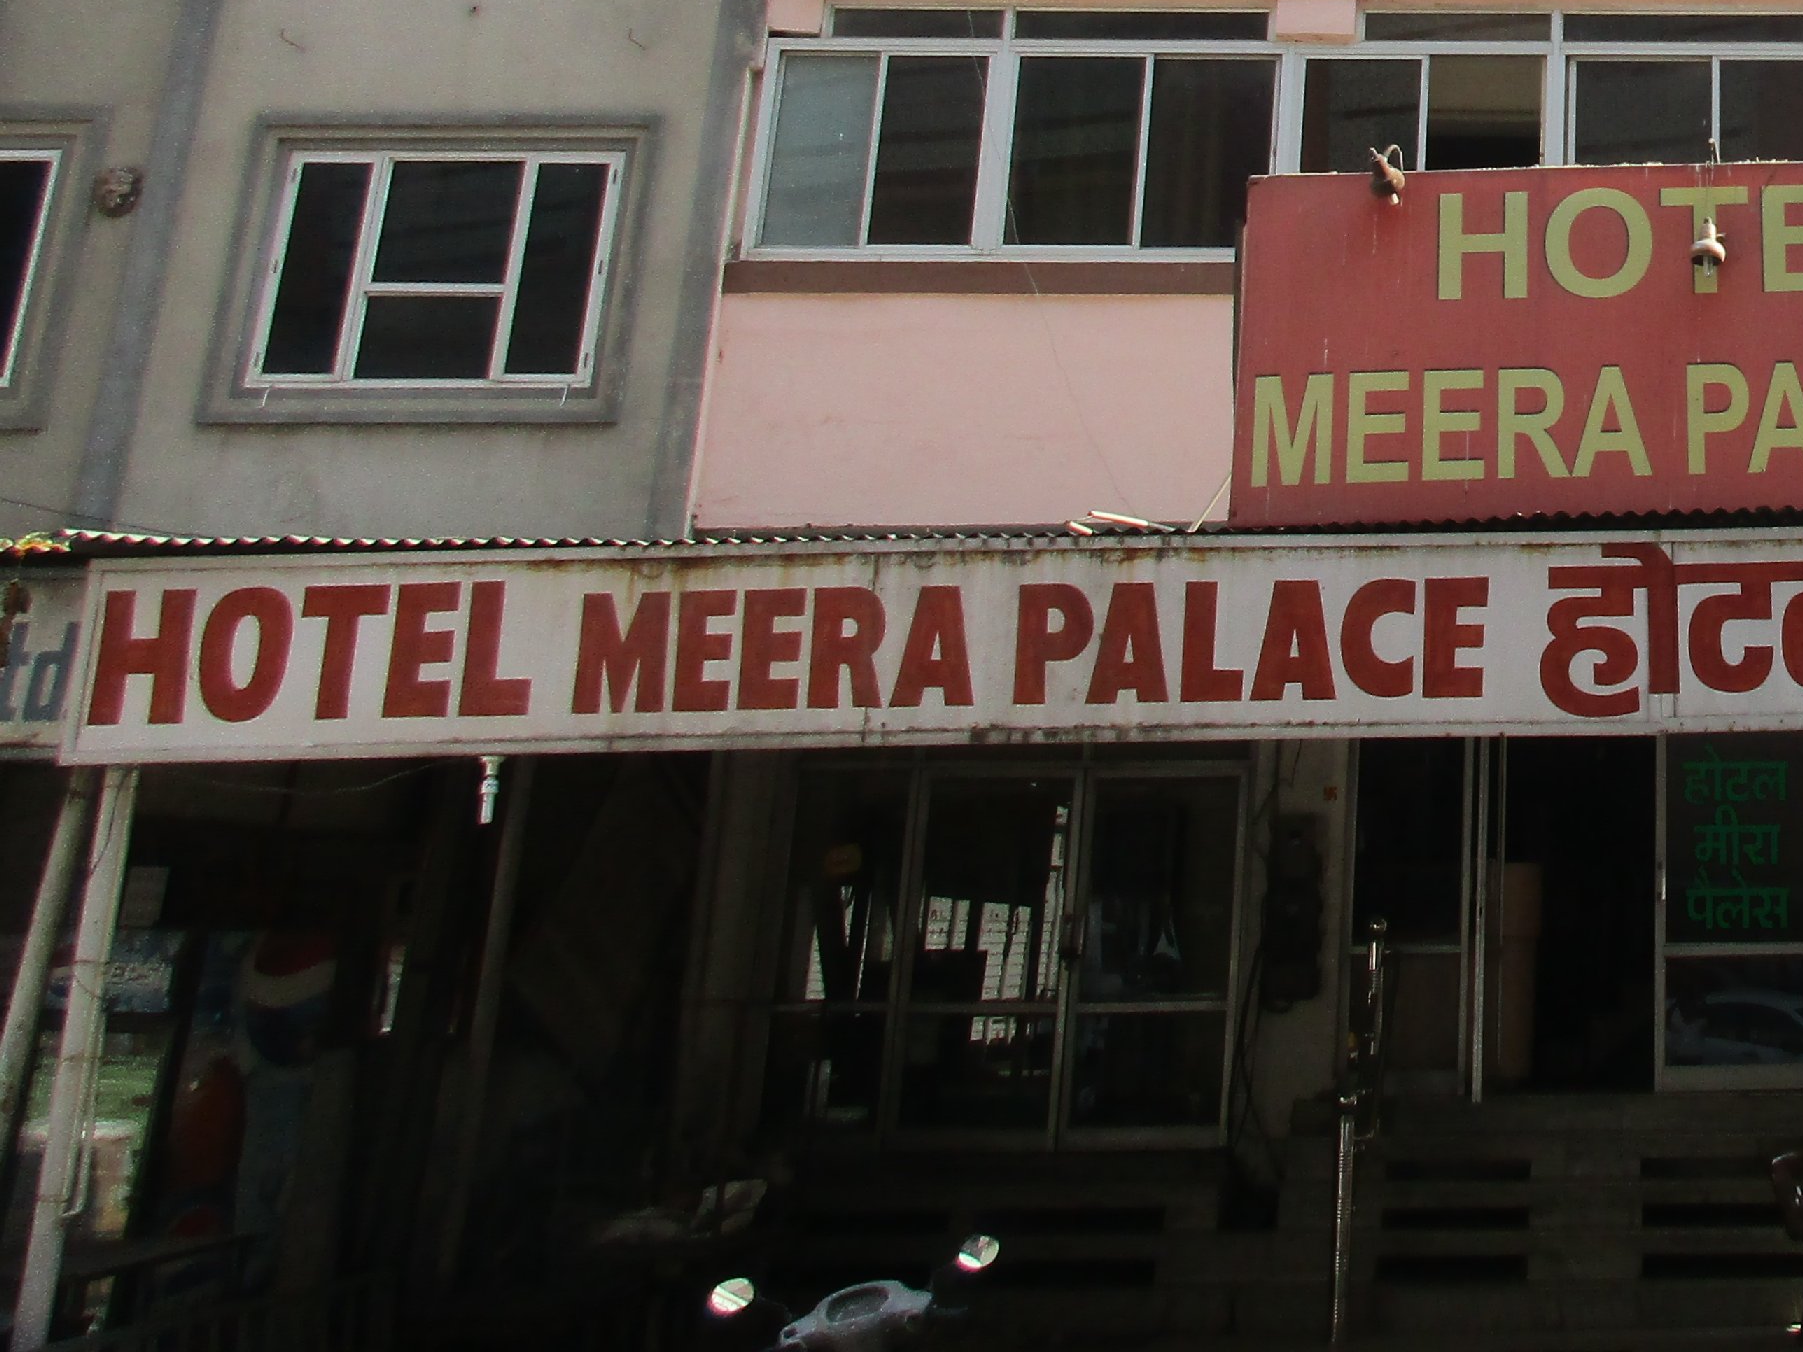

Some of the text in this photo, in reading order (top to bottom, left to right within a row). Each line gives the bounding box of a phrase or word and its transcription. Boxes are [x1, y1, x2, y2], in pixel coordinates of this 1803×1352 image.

[1250, 365, 1653, 488] MEERA
[87, 576, 1490, 725] HOTEL MEERA PALACE
[1681, 744, 1790, 804] होटल
[1694, 803, 1782, 866] मीरा
